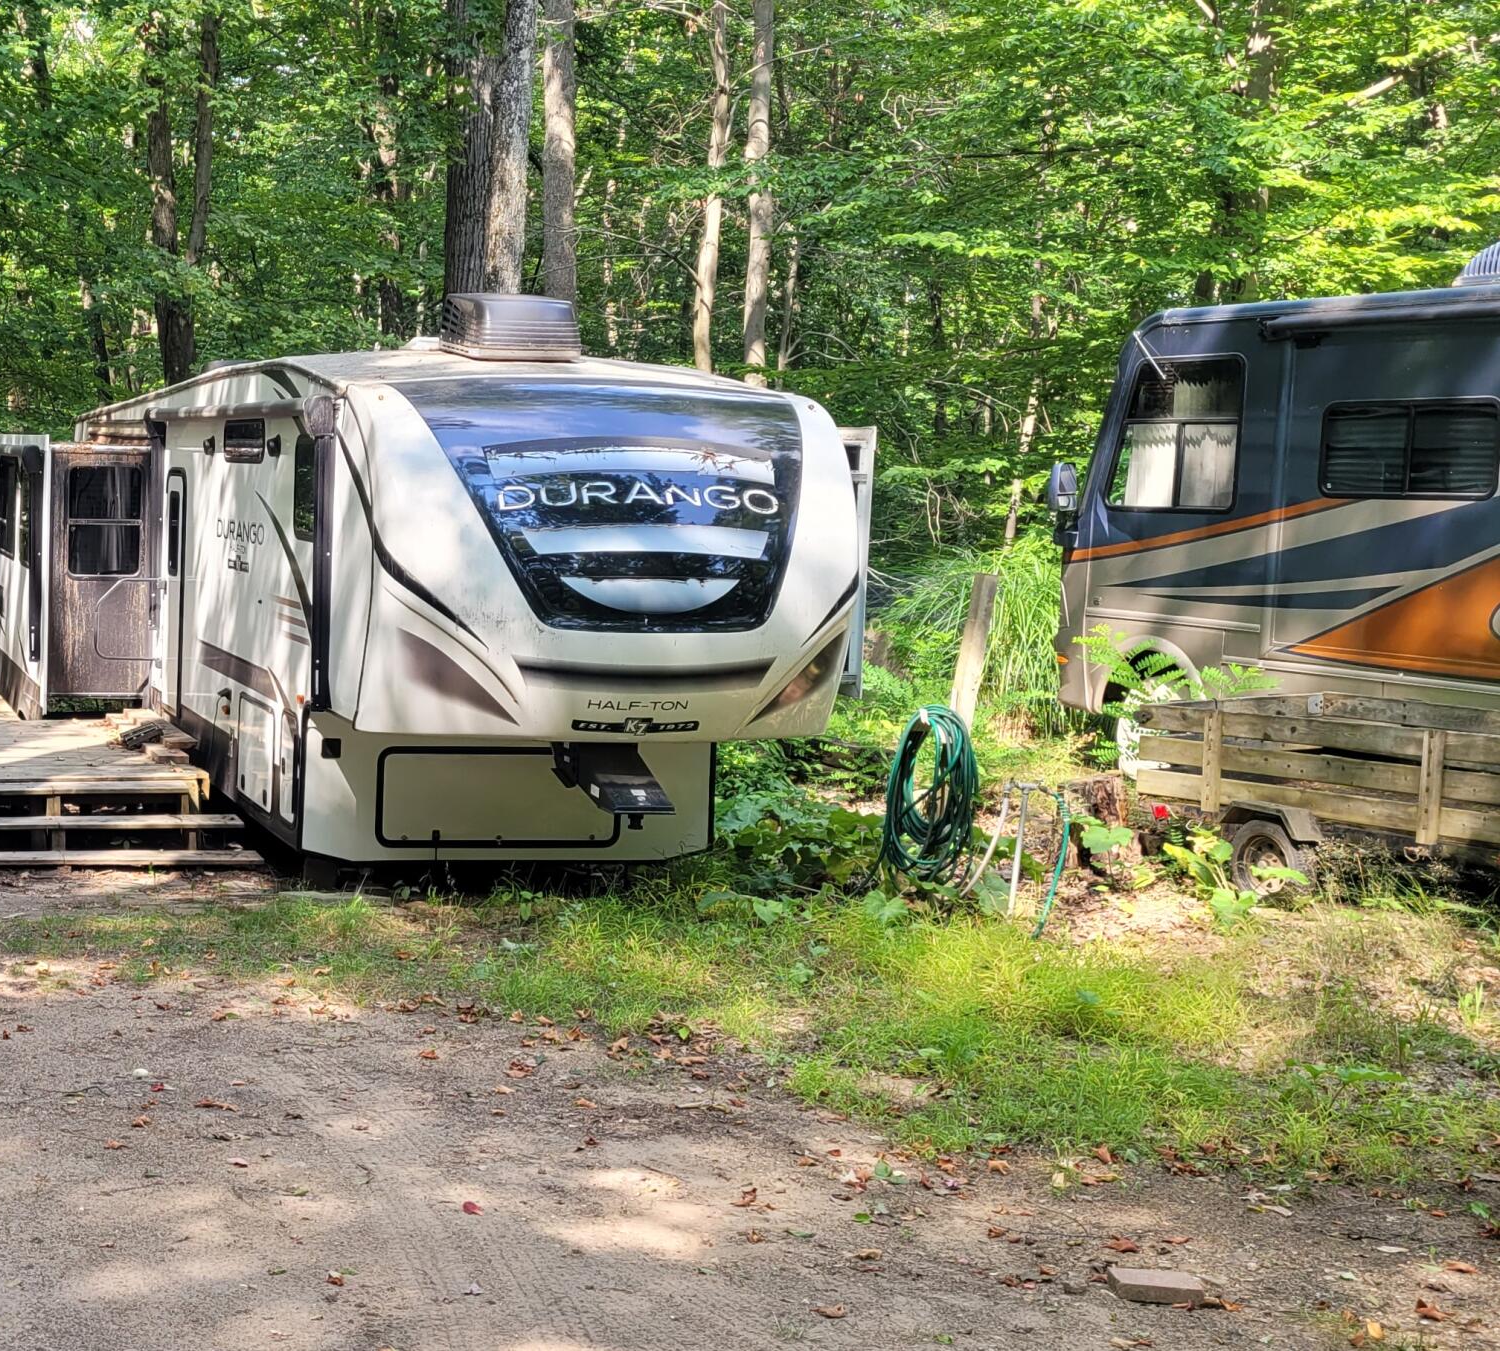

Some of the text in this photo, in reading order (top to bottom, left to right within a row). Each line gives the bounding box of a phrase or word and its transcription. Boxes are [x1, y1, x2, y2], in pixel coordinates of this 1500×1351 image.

[498, 480, 779, 515] DURANGO
[216, 518, 265, 546] DURANGO
[587, 699, 689, 711] HALF-TON
[578, 722, 612, 730] EST.
[625, 719, 648, 736] KZ
